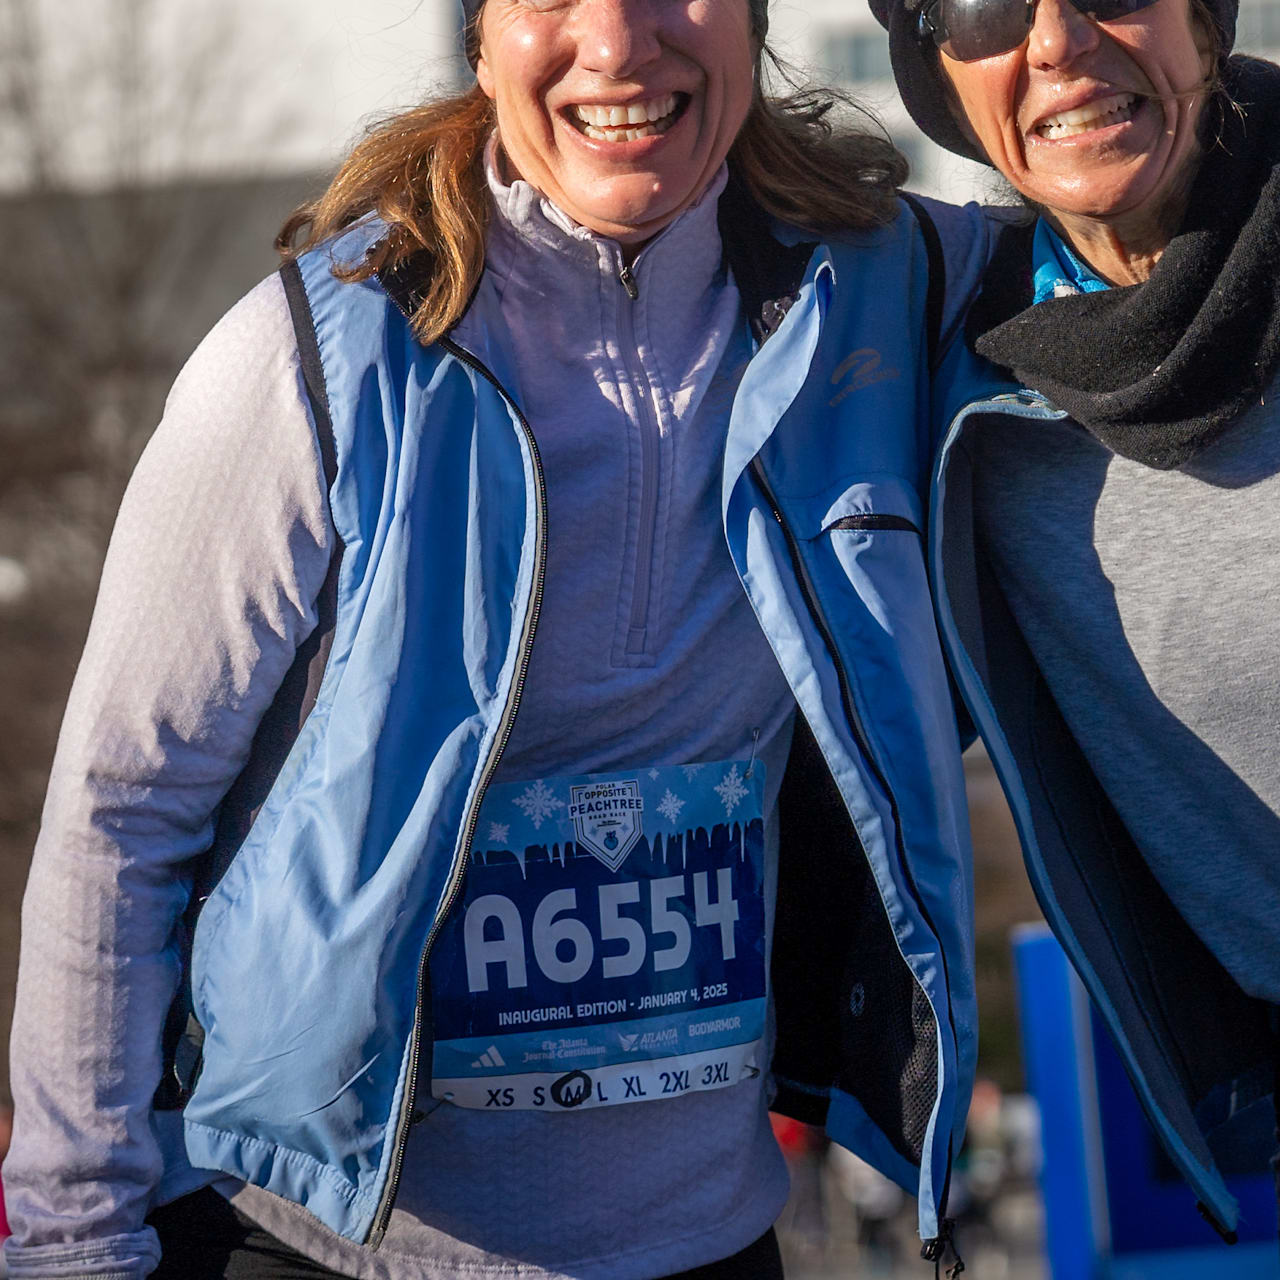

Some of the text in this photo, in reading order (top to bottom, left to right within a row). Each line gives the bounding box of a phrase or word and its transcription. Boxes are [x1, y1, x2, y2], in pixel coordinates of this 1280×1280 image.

[585, 788, 626, 800] OPPOSITE
[570, 798, 642, 816] PEACHTREE
[464, 867, 739, 992] A6554
[499, 1006, 573, 1026] INAUGURAL
[577, 999, 627, 1018] EDITION
[638, 990, 687, 1010] JANUARY
[690, 988, 701, 1001] 4,
[703, 983, 728, 999] 2025
[640, 1028, 679, 1043] ATLANTA
[689, 1016, 741, 1037] BODYARMOR
[485, 1088, 515, 1107] XS
[533, 1086, 545, 1106] S
[597, 1082, 608, 1101] L
[622, 1076, 646, 1098] XL
[659, 1070, 690, 1094] 2XL
[702, 1062, 729, 1085] 3XL
